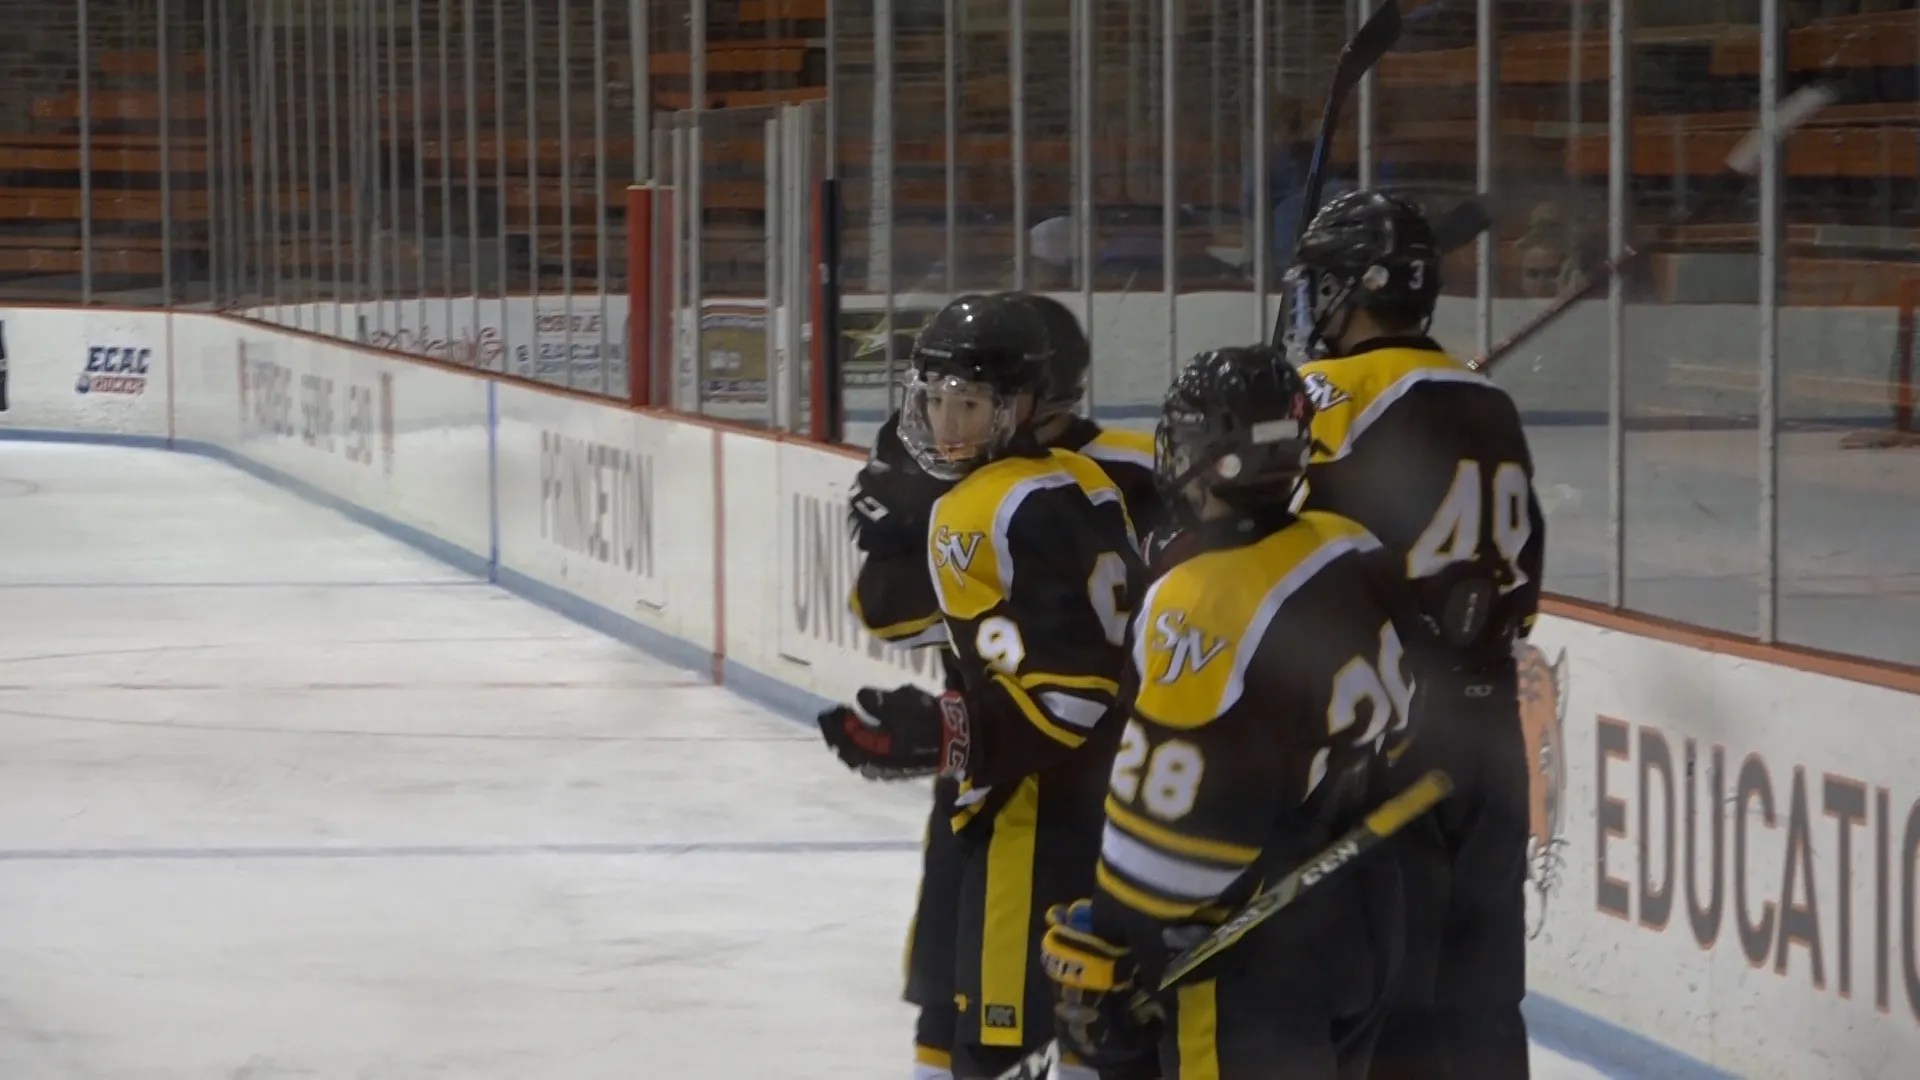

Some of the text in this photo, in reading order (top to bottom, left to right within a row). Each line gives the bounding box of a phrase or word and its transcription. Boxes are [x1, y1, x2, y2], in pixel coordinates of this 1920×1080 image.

[1408, 259, 1425, 291] 3
[86, 346, 151, 374] ECAC
[1406, 458, 1531, 595] 49
[974, 615, 1026, 674] 9
[1110, 716, 1204, 821] 28
